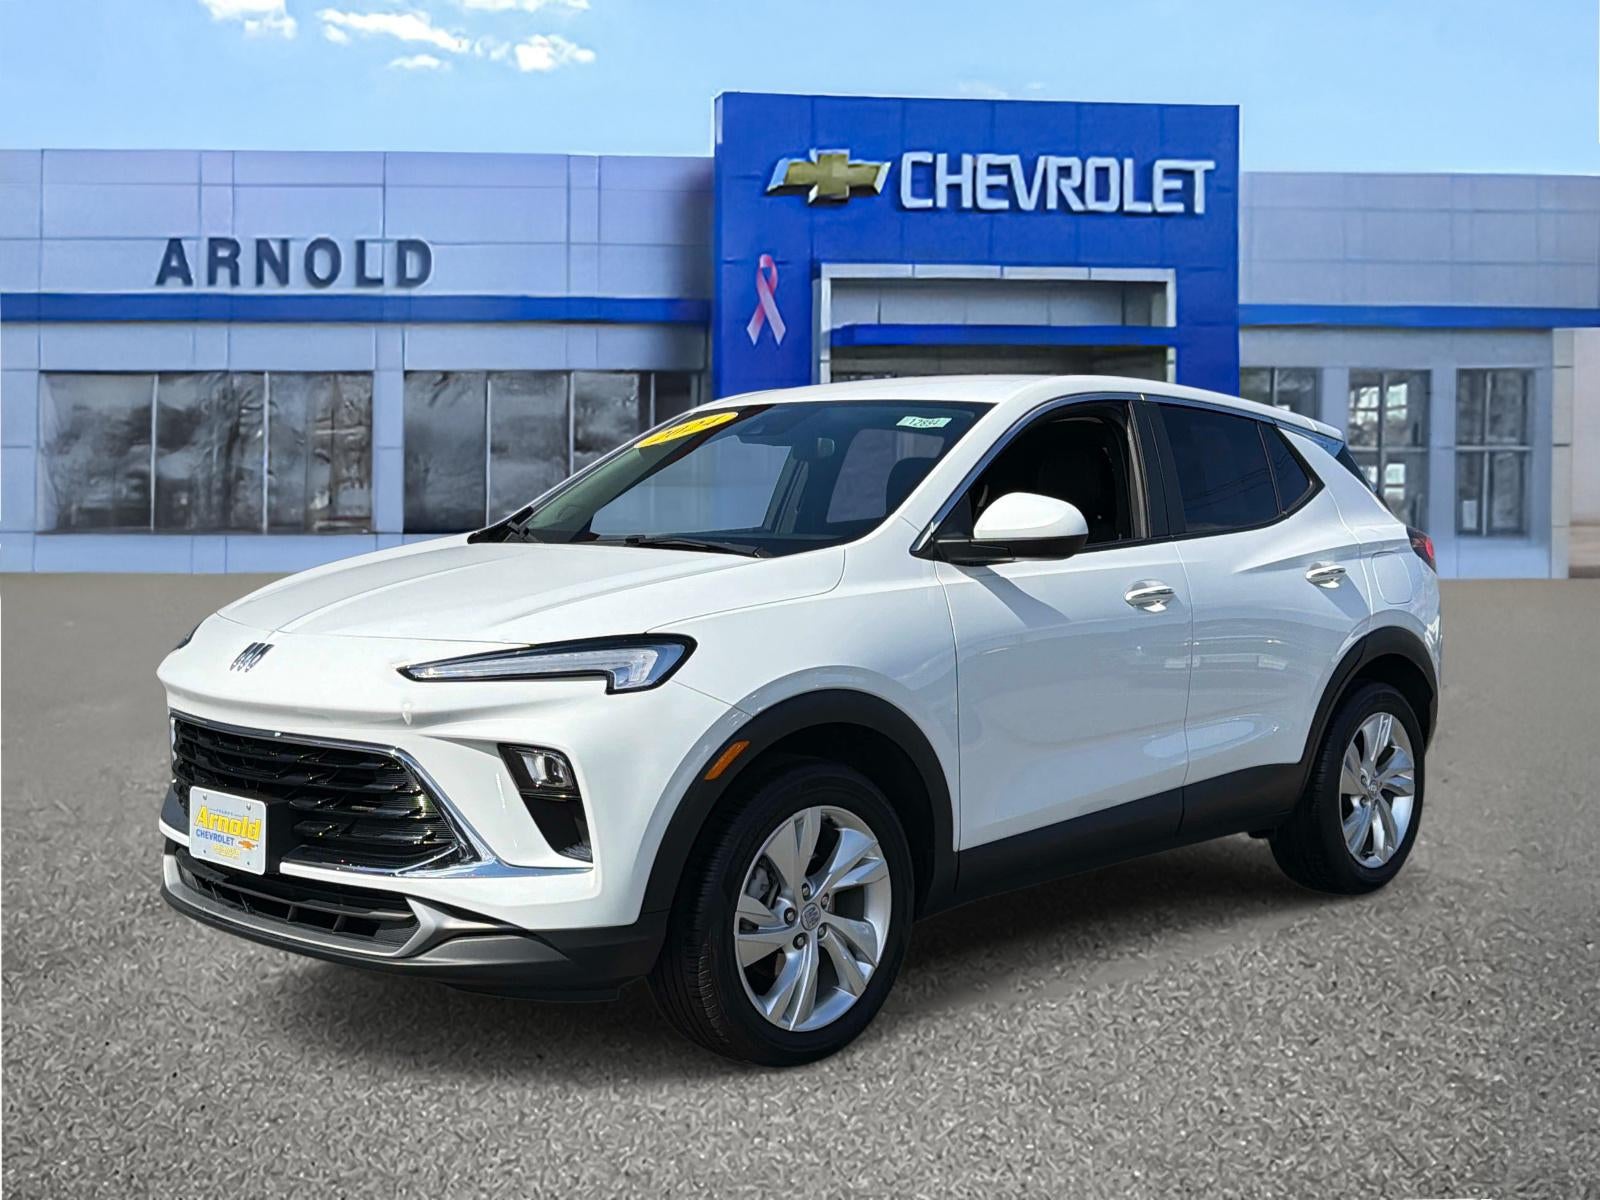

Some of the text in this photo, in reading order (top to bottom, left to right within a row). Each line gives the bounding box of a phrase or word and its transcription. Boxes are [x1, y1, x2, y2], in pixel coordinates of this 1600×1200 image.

[900, 151, 1215, 214] CHEVROLET
[155, 237, 432, 289] ARNOLD
[195, 805, 261, 841] Arnold
[195, 828, 234, 846] CHEVROLET
